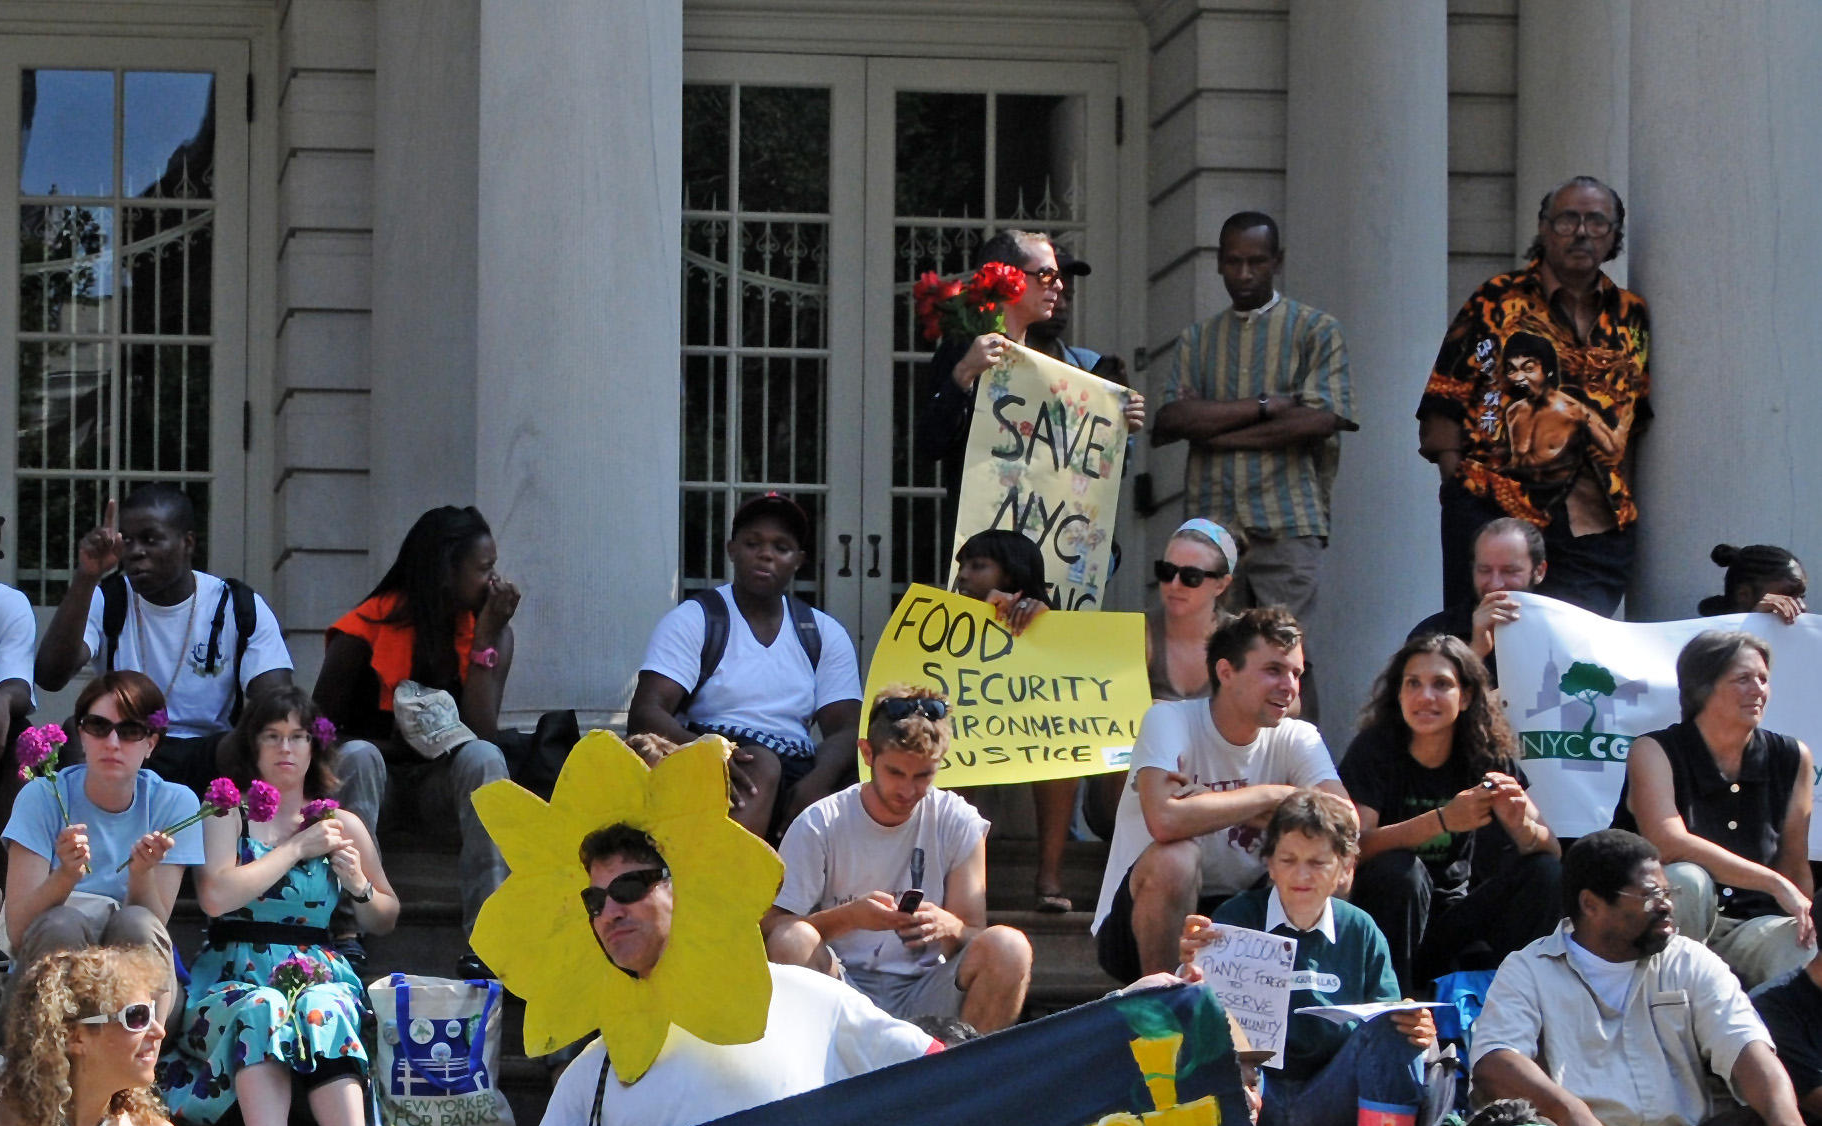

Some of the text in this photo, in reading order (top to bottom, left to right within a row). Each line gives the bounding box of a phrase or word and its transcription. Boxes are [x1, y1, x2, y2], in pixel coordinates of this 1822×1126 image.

[991, 394, 1112, 480] SAVE
[991, 486, 1091, 565] NYC
[894, 597, 1014, 663] FOOD
[922, 662, 1112, 706] SECURITY
[950, 714, 1136, 740] IRONMENTAL
